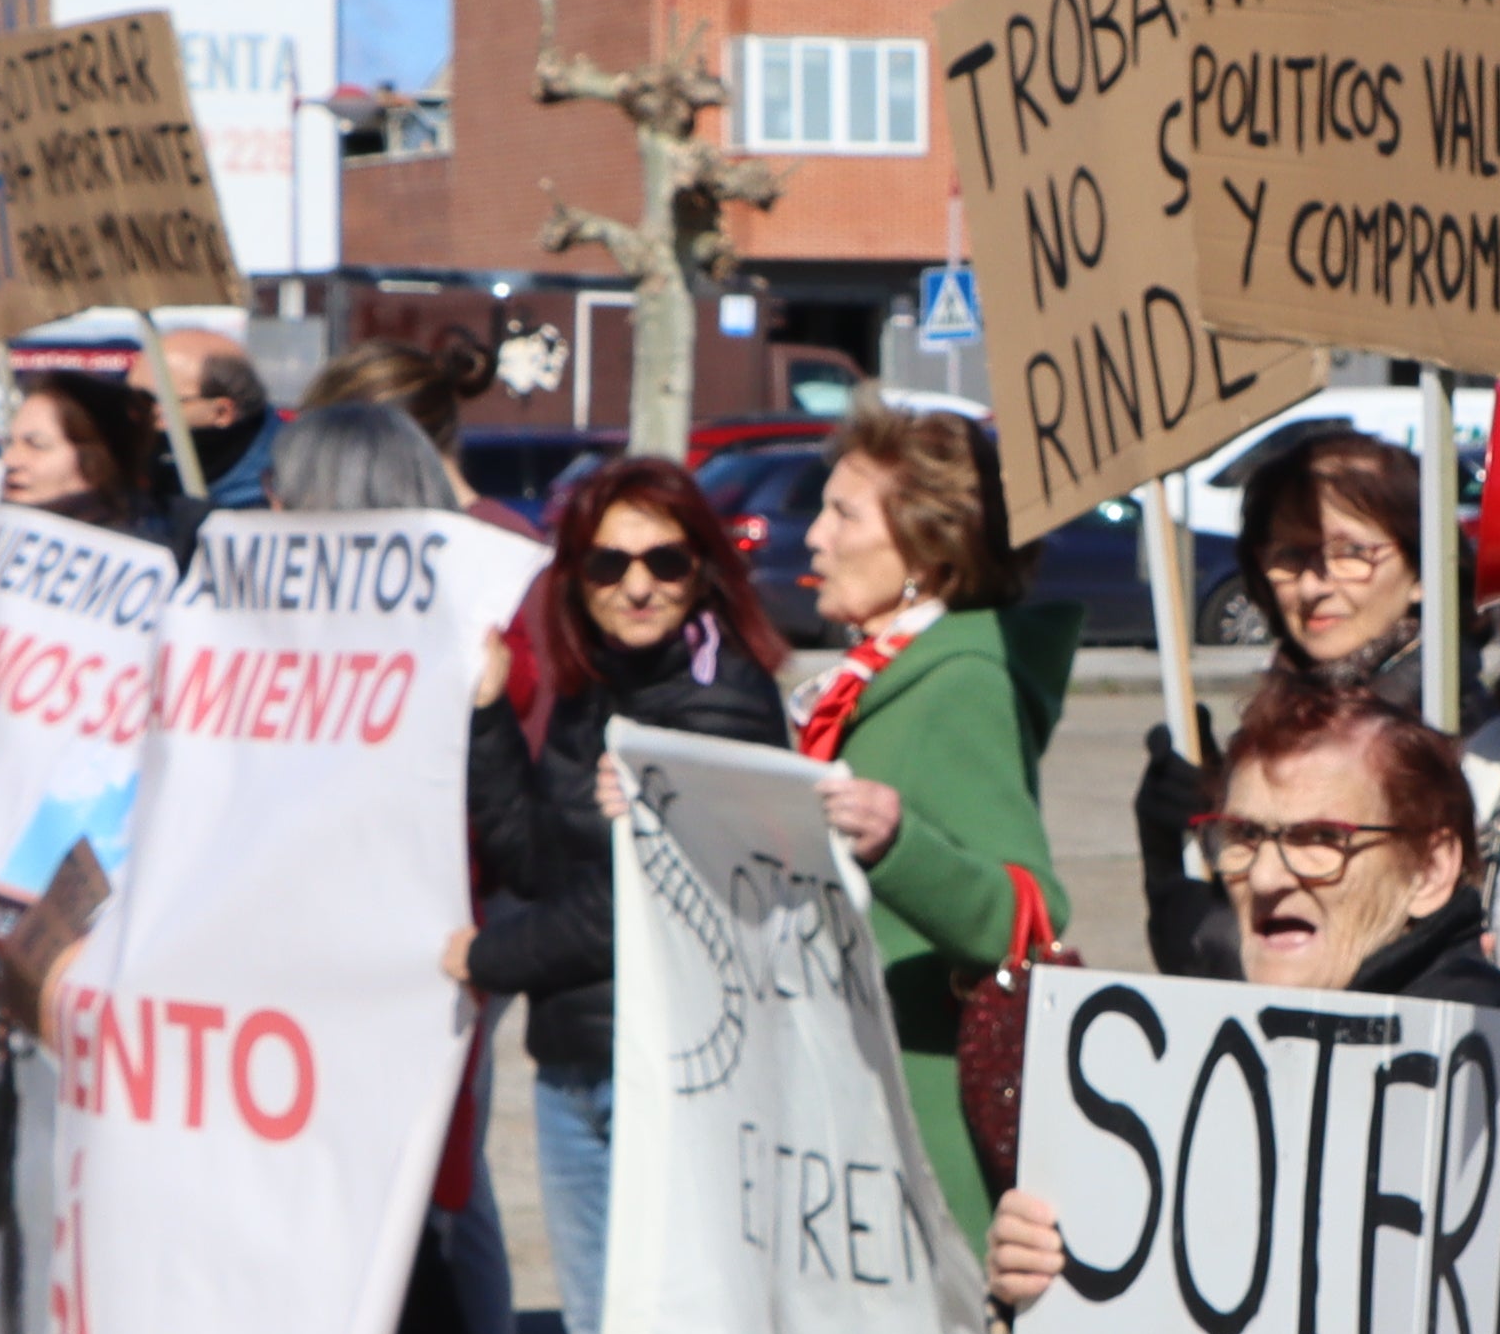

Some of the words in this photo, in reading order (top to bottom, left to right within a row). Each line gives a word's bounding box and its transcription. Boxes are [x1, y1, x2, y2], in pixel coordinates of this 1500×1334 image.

[1191, 43, 1404, 157] POLITICOS
[1023, 165, 1107, 310] NO
[1223, 178, 1268, 291] Y
